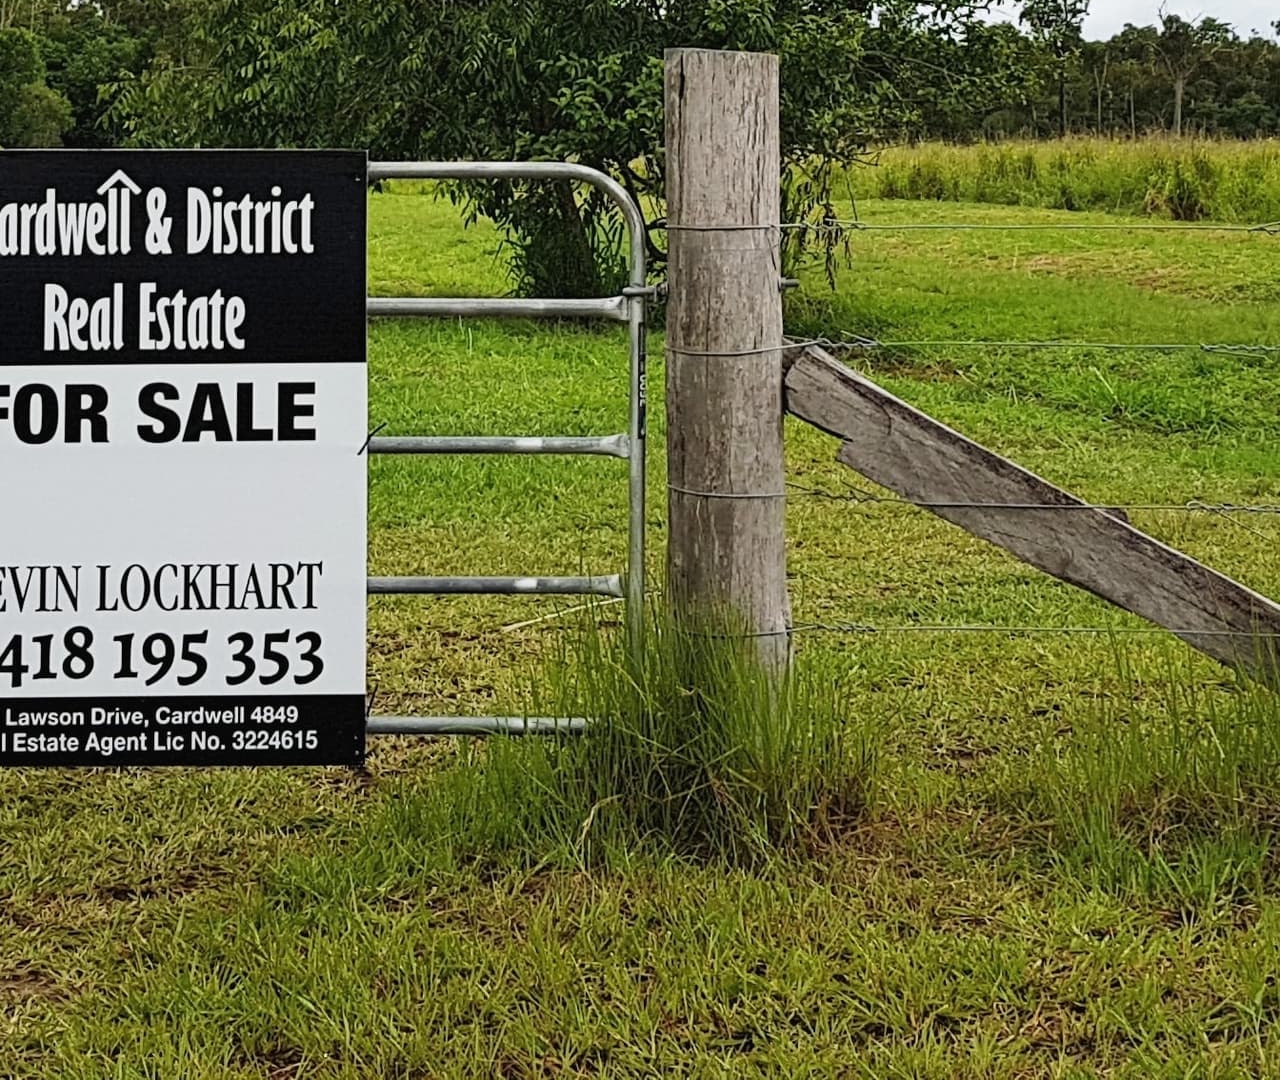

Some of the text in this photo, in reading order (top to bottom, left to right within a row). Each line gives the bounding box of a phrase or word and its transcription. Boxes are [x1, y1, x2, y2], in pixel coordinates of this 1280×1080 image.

[145, 187, 173, 254] &
[187, 186, 315, 254] District
[44, 283, 246, 351] Real Estate
[136, 382, 317, 443] SALE
[95, 561, 323, 612] LOCKHART
[113, 629, 209, 687] 195
[225, 629, 324, 686] 353
[5, 708, 85, 726] Lawson
[91, 707, 149, 728] Drive,
[155, 706, 245, 725] Cardwell
[250, 705, 299, 724] 4849
[13, 732, 80, 752] Estate
[84, 731, 148, 756] Agent
[153, 731, 185, 751] Lic
[191, 731, 226, 751] No.
[232, 730, 318, 750] 3224615
